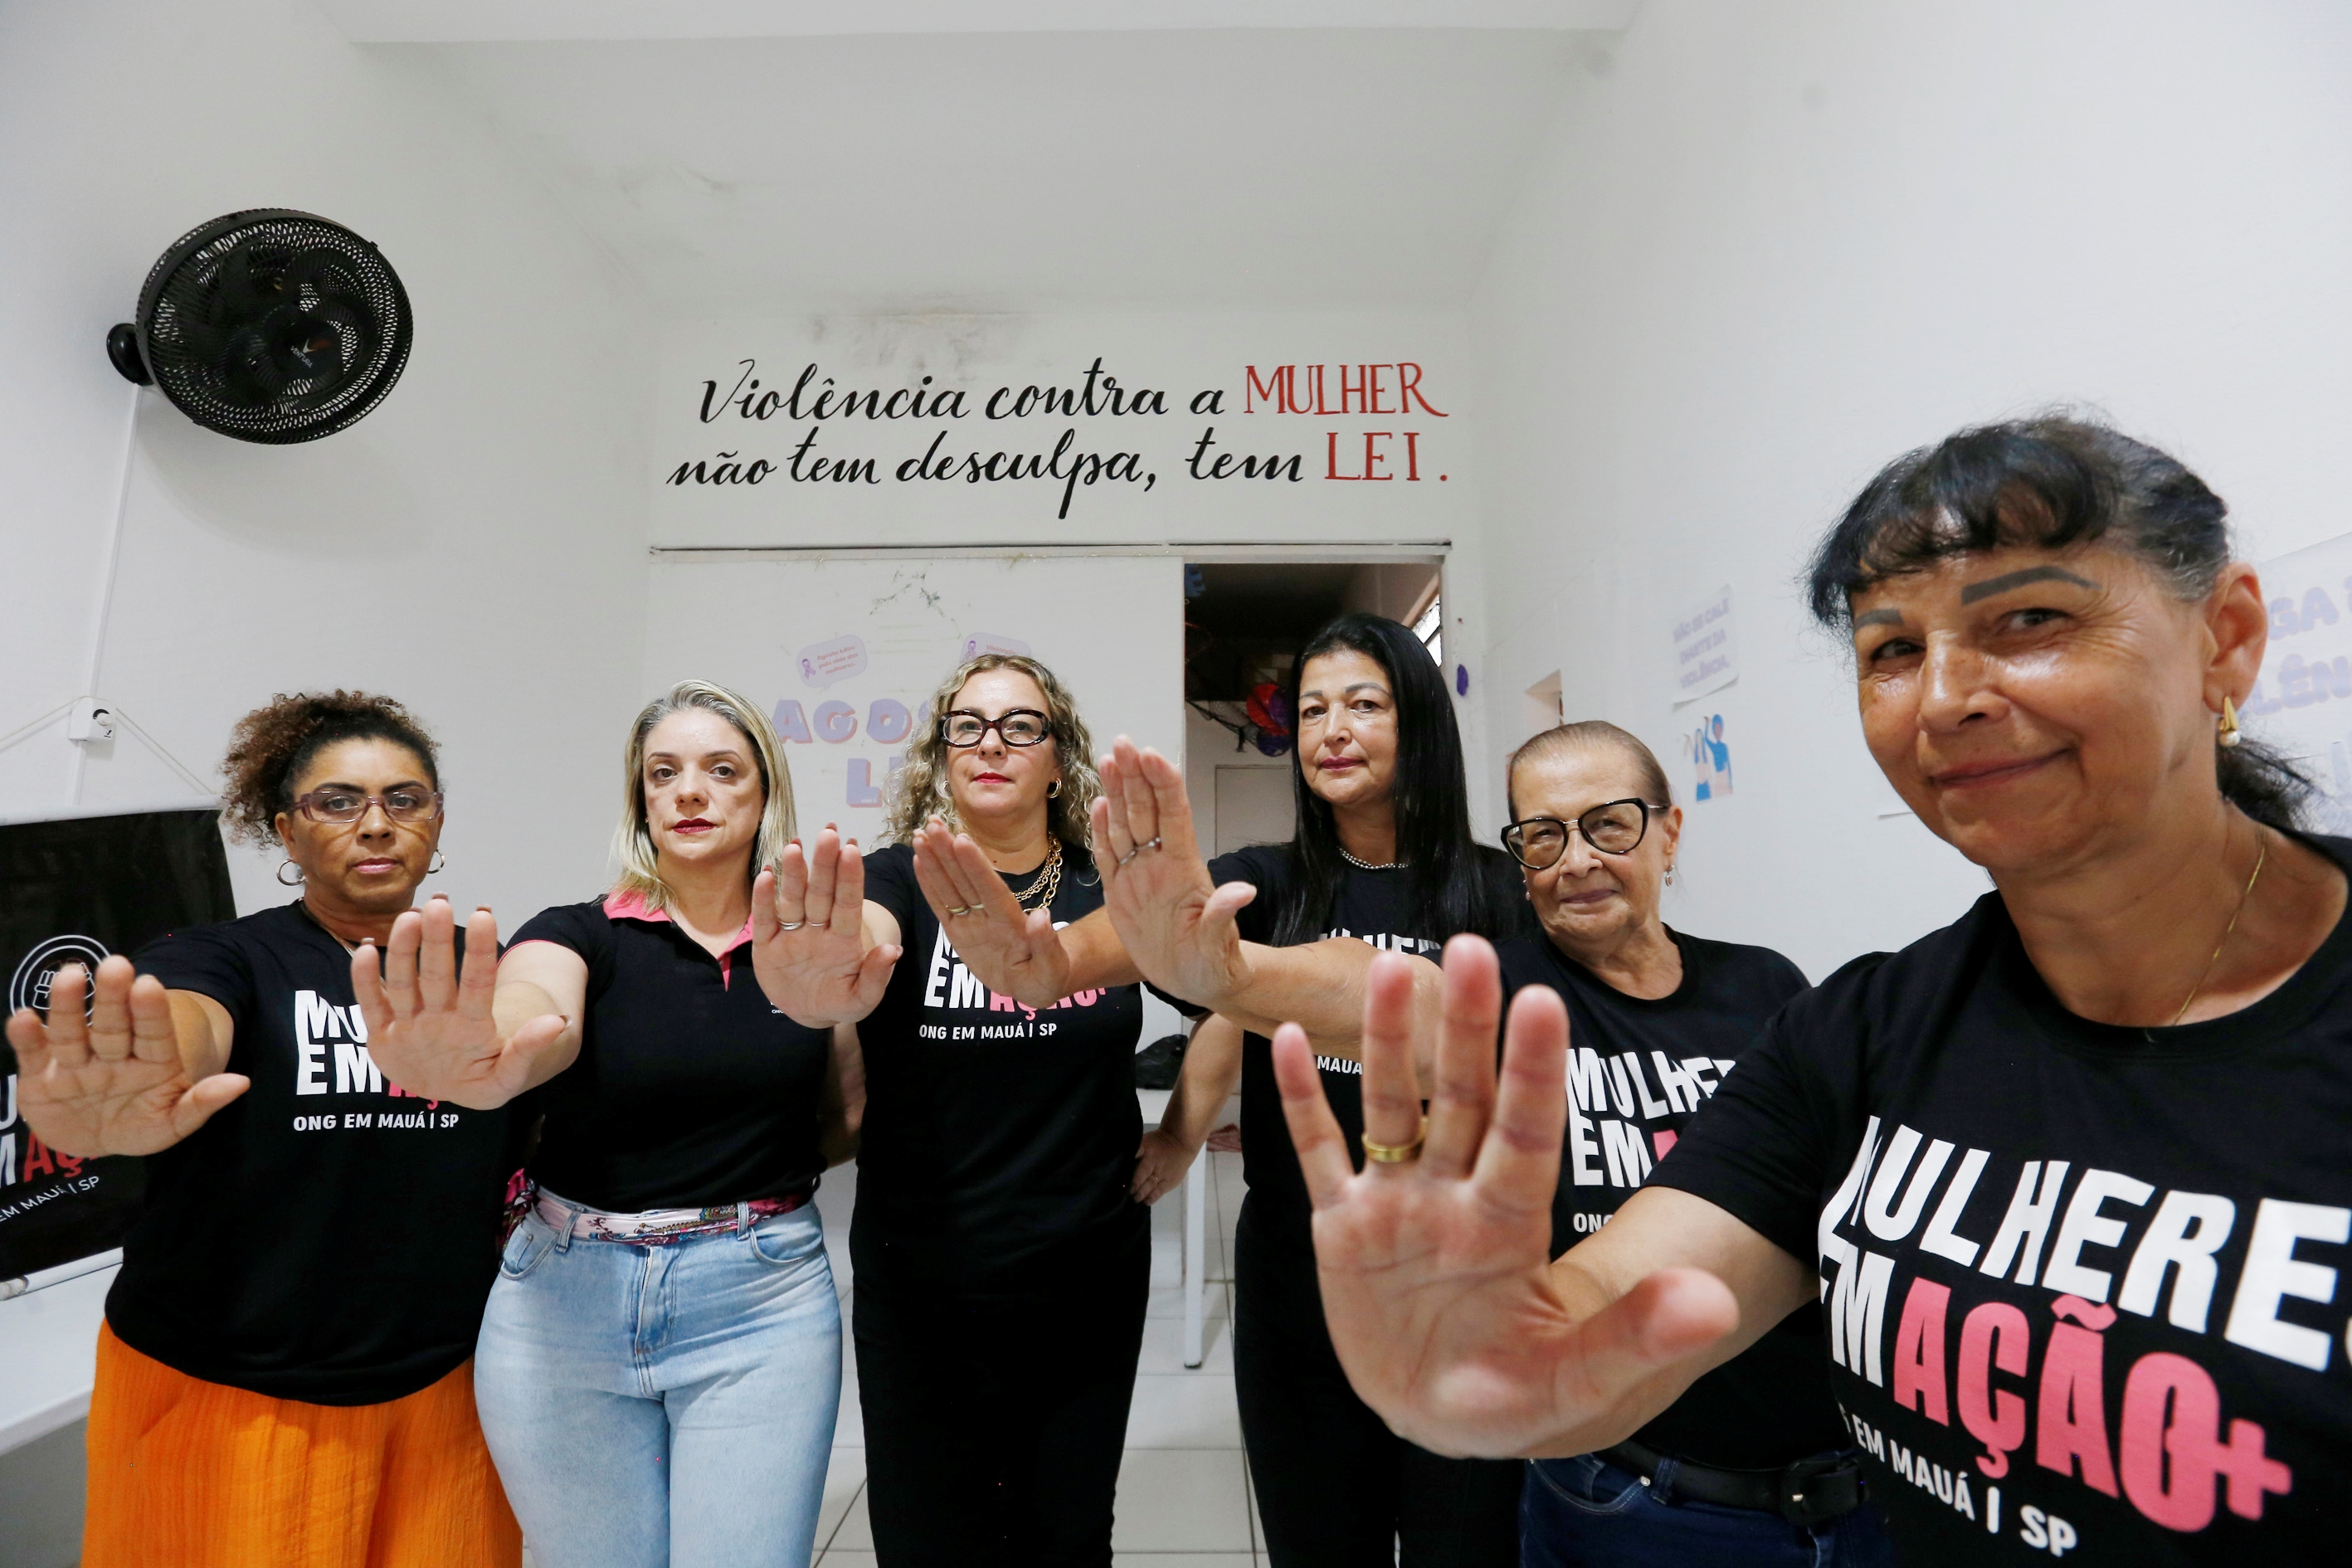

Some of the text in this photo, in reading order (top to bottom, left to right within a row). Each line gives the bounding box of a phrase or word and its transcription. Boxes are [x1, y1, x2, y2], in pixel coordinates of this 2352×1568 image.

[700, 358, 1449, 423] Violência contra a MULHER
[666, 449, 777, 486] não
[786, 426, 880, 484] tem
[895, 428, 1157, 520] desculpa,
[1185, 426, 1303, 483] tem
[772, 699, 929, 744] AGO
[918, 1024, 947, 1039] ONG
[952, 1026, 975, 1040] EM
[981, 1021, 1025, 1039] MAUÁ
[1039, 1023, 1057, 1036] SP
[294, 1115, 337, 1132] ONG
[344, 1113, 373, 1128] EM
[377, 1111, 426, 1128] MAUÁ
[440, 1114, 459, 1128] SP
[78, 1176, 100, 1191] SP
[1852, 1414, 1886, 1463] EM
[1890, 1439, 1975, 1521] MAUÁ
[2020, 1505, 2077, 1556] SP
